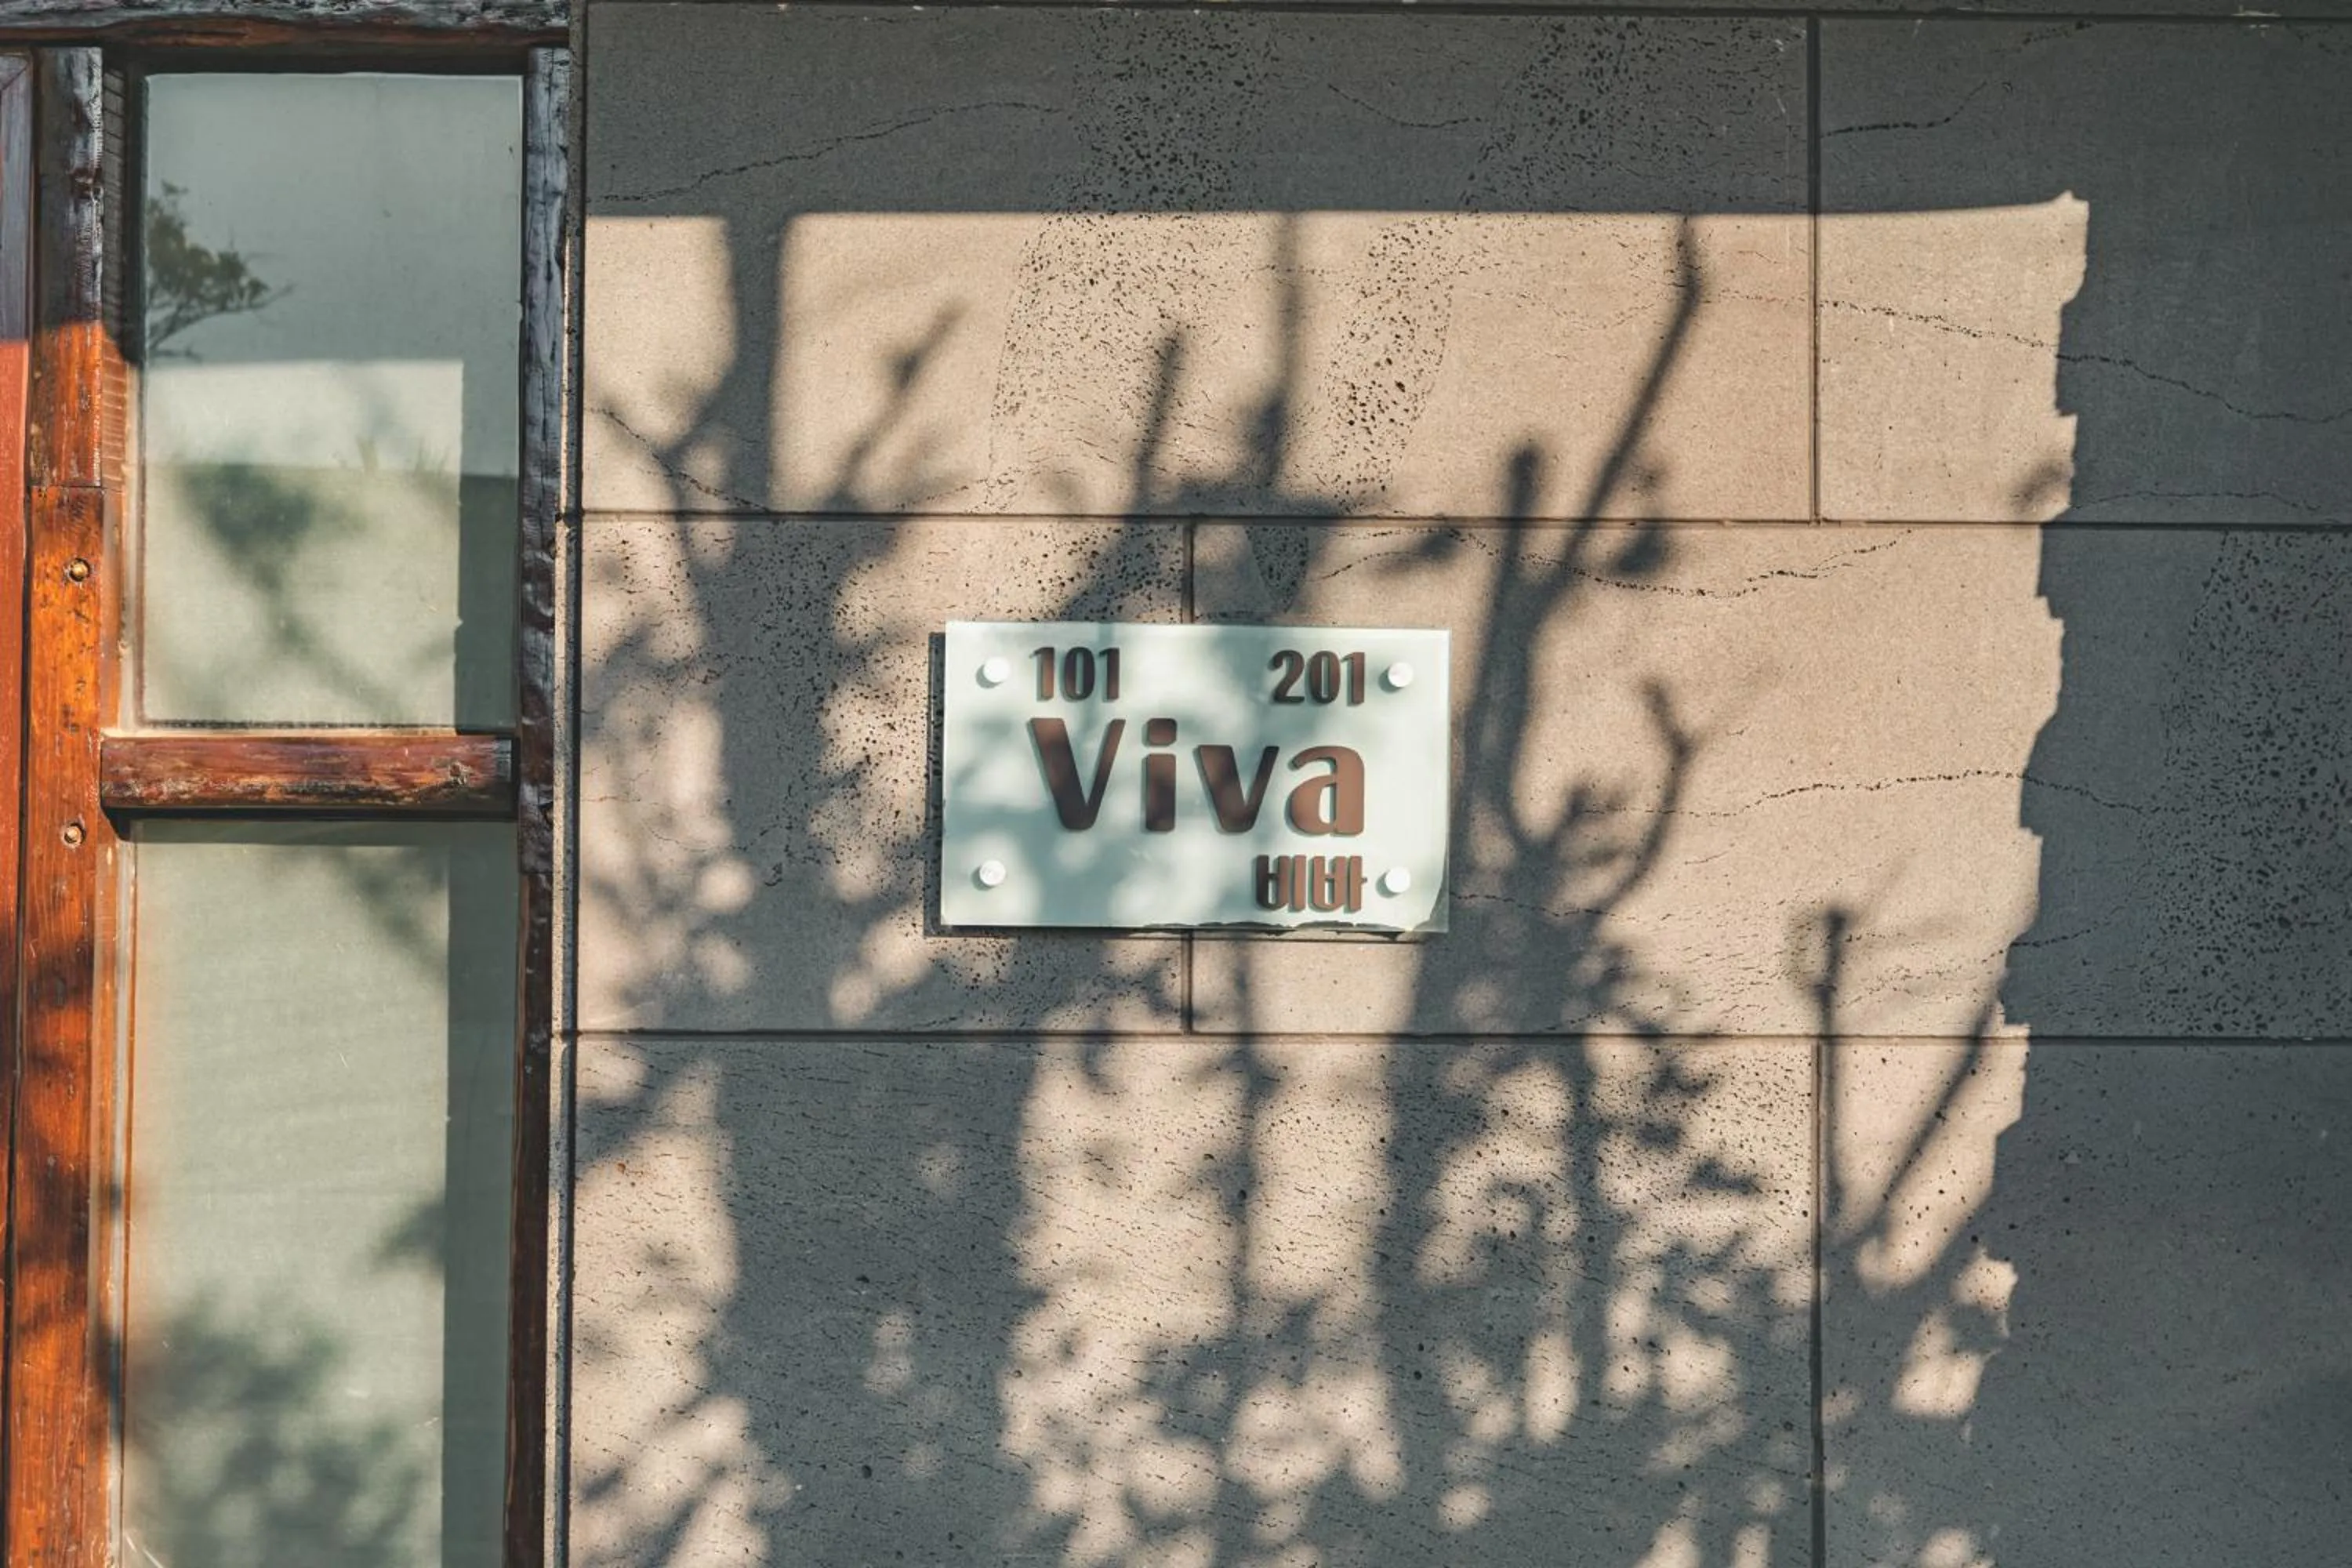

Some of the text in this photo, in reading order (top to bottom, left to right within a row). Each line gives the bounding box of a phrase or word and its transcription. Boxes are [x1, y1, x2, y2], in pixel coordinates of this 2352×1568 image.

[1030, 647, 1121, 701] 101
[1269, 649, 1367, 705] 201
[1029, 717, 1366, 836] Viva
[1255, 855, 1367, 913] 비바
